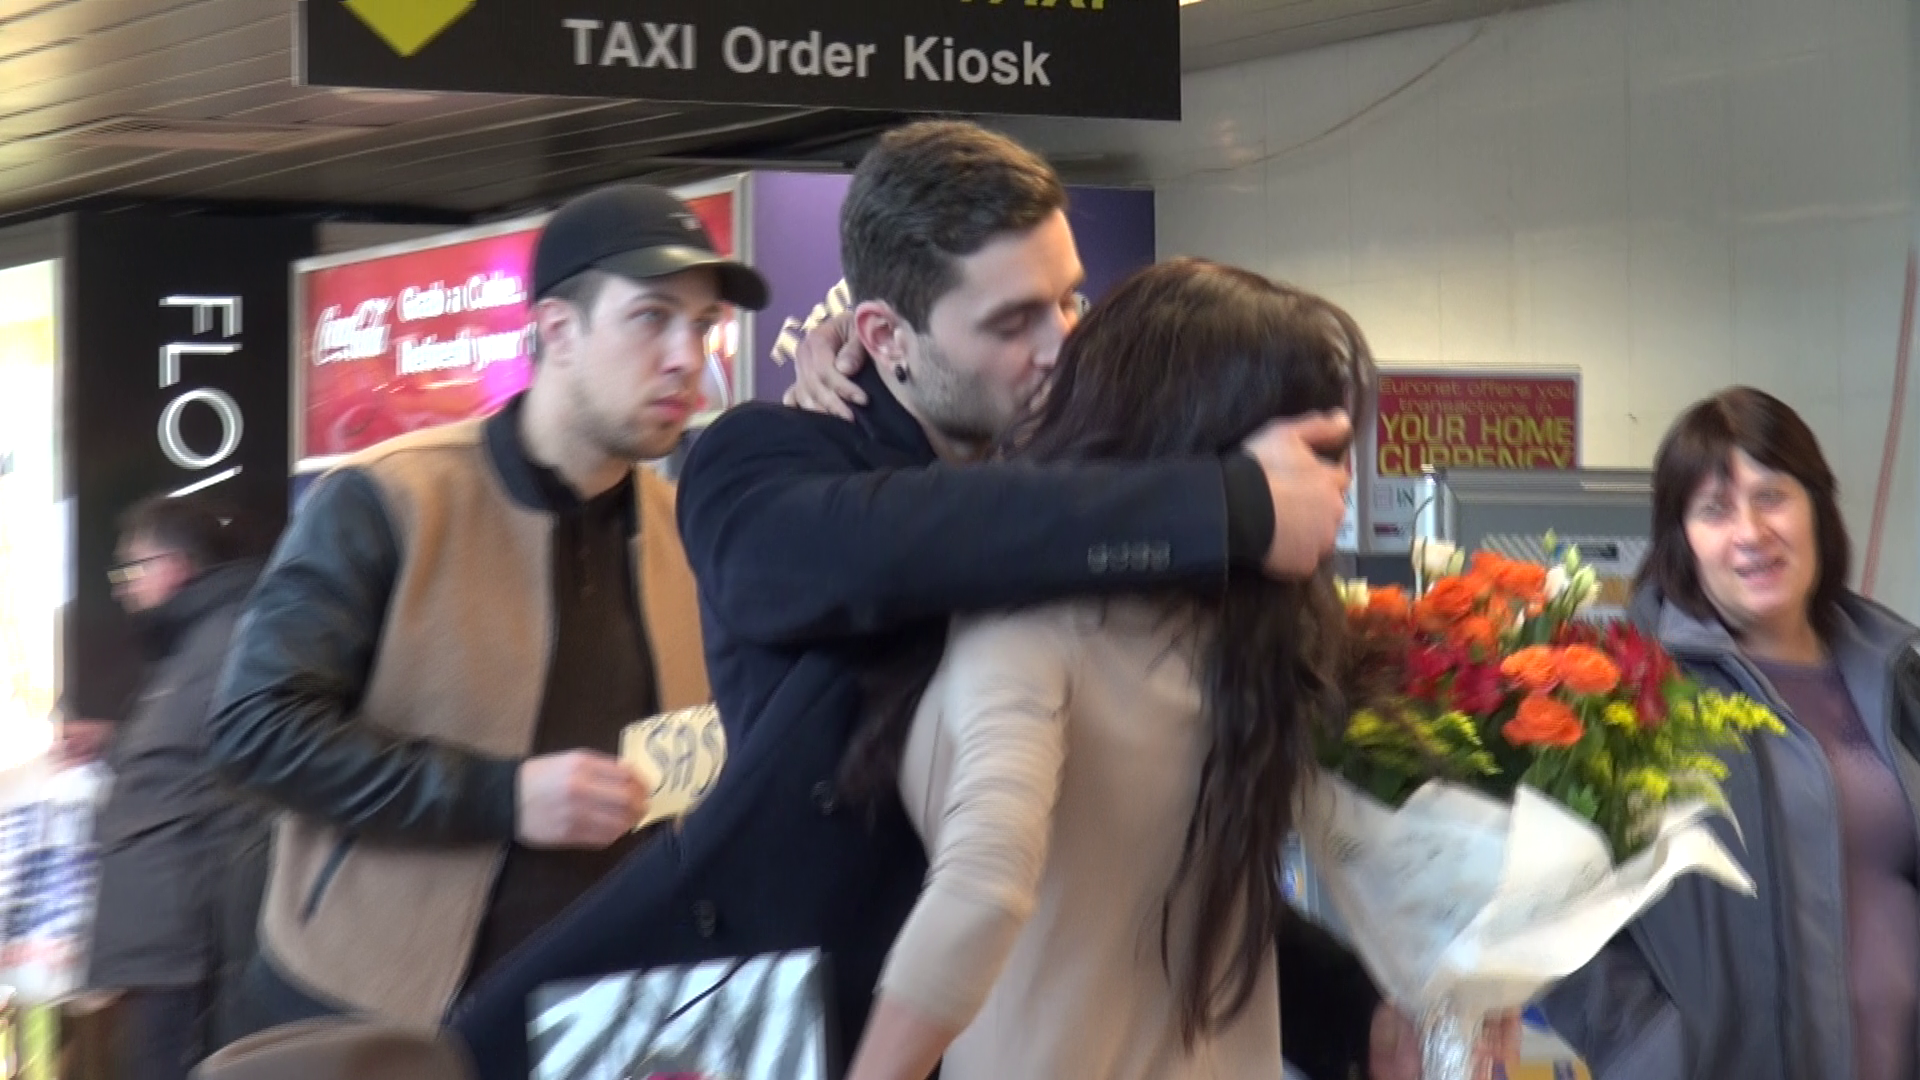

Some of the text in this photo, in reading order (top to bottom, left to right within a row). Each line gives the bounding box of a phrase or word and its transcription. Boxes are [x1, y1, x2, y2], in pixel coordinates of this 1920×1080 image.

[562, 18, 1052, 87] TAXI Order Kiosk
[1380, 376, 1461, 397] Euronet
[1467, 379, 1532, 398] offers
[1380, 412, 1574, 447] YOUR HOME
